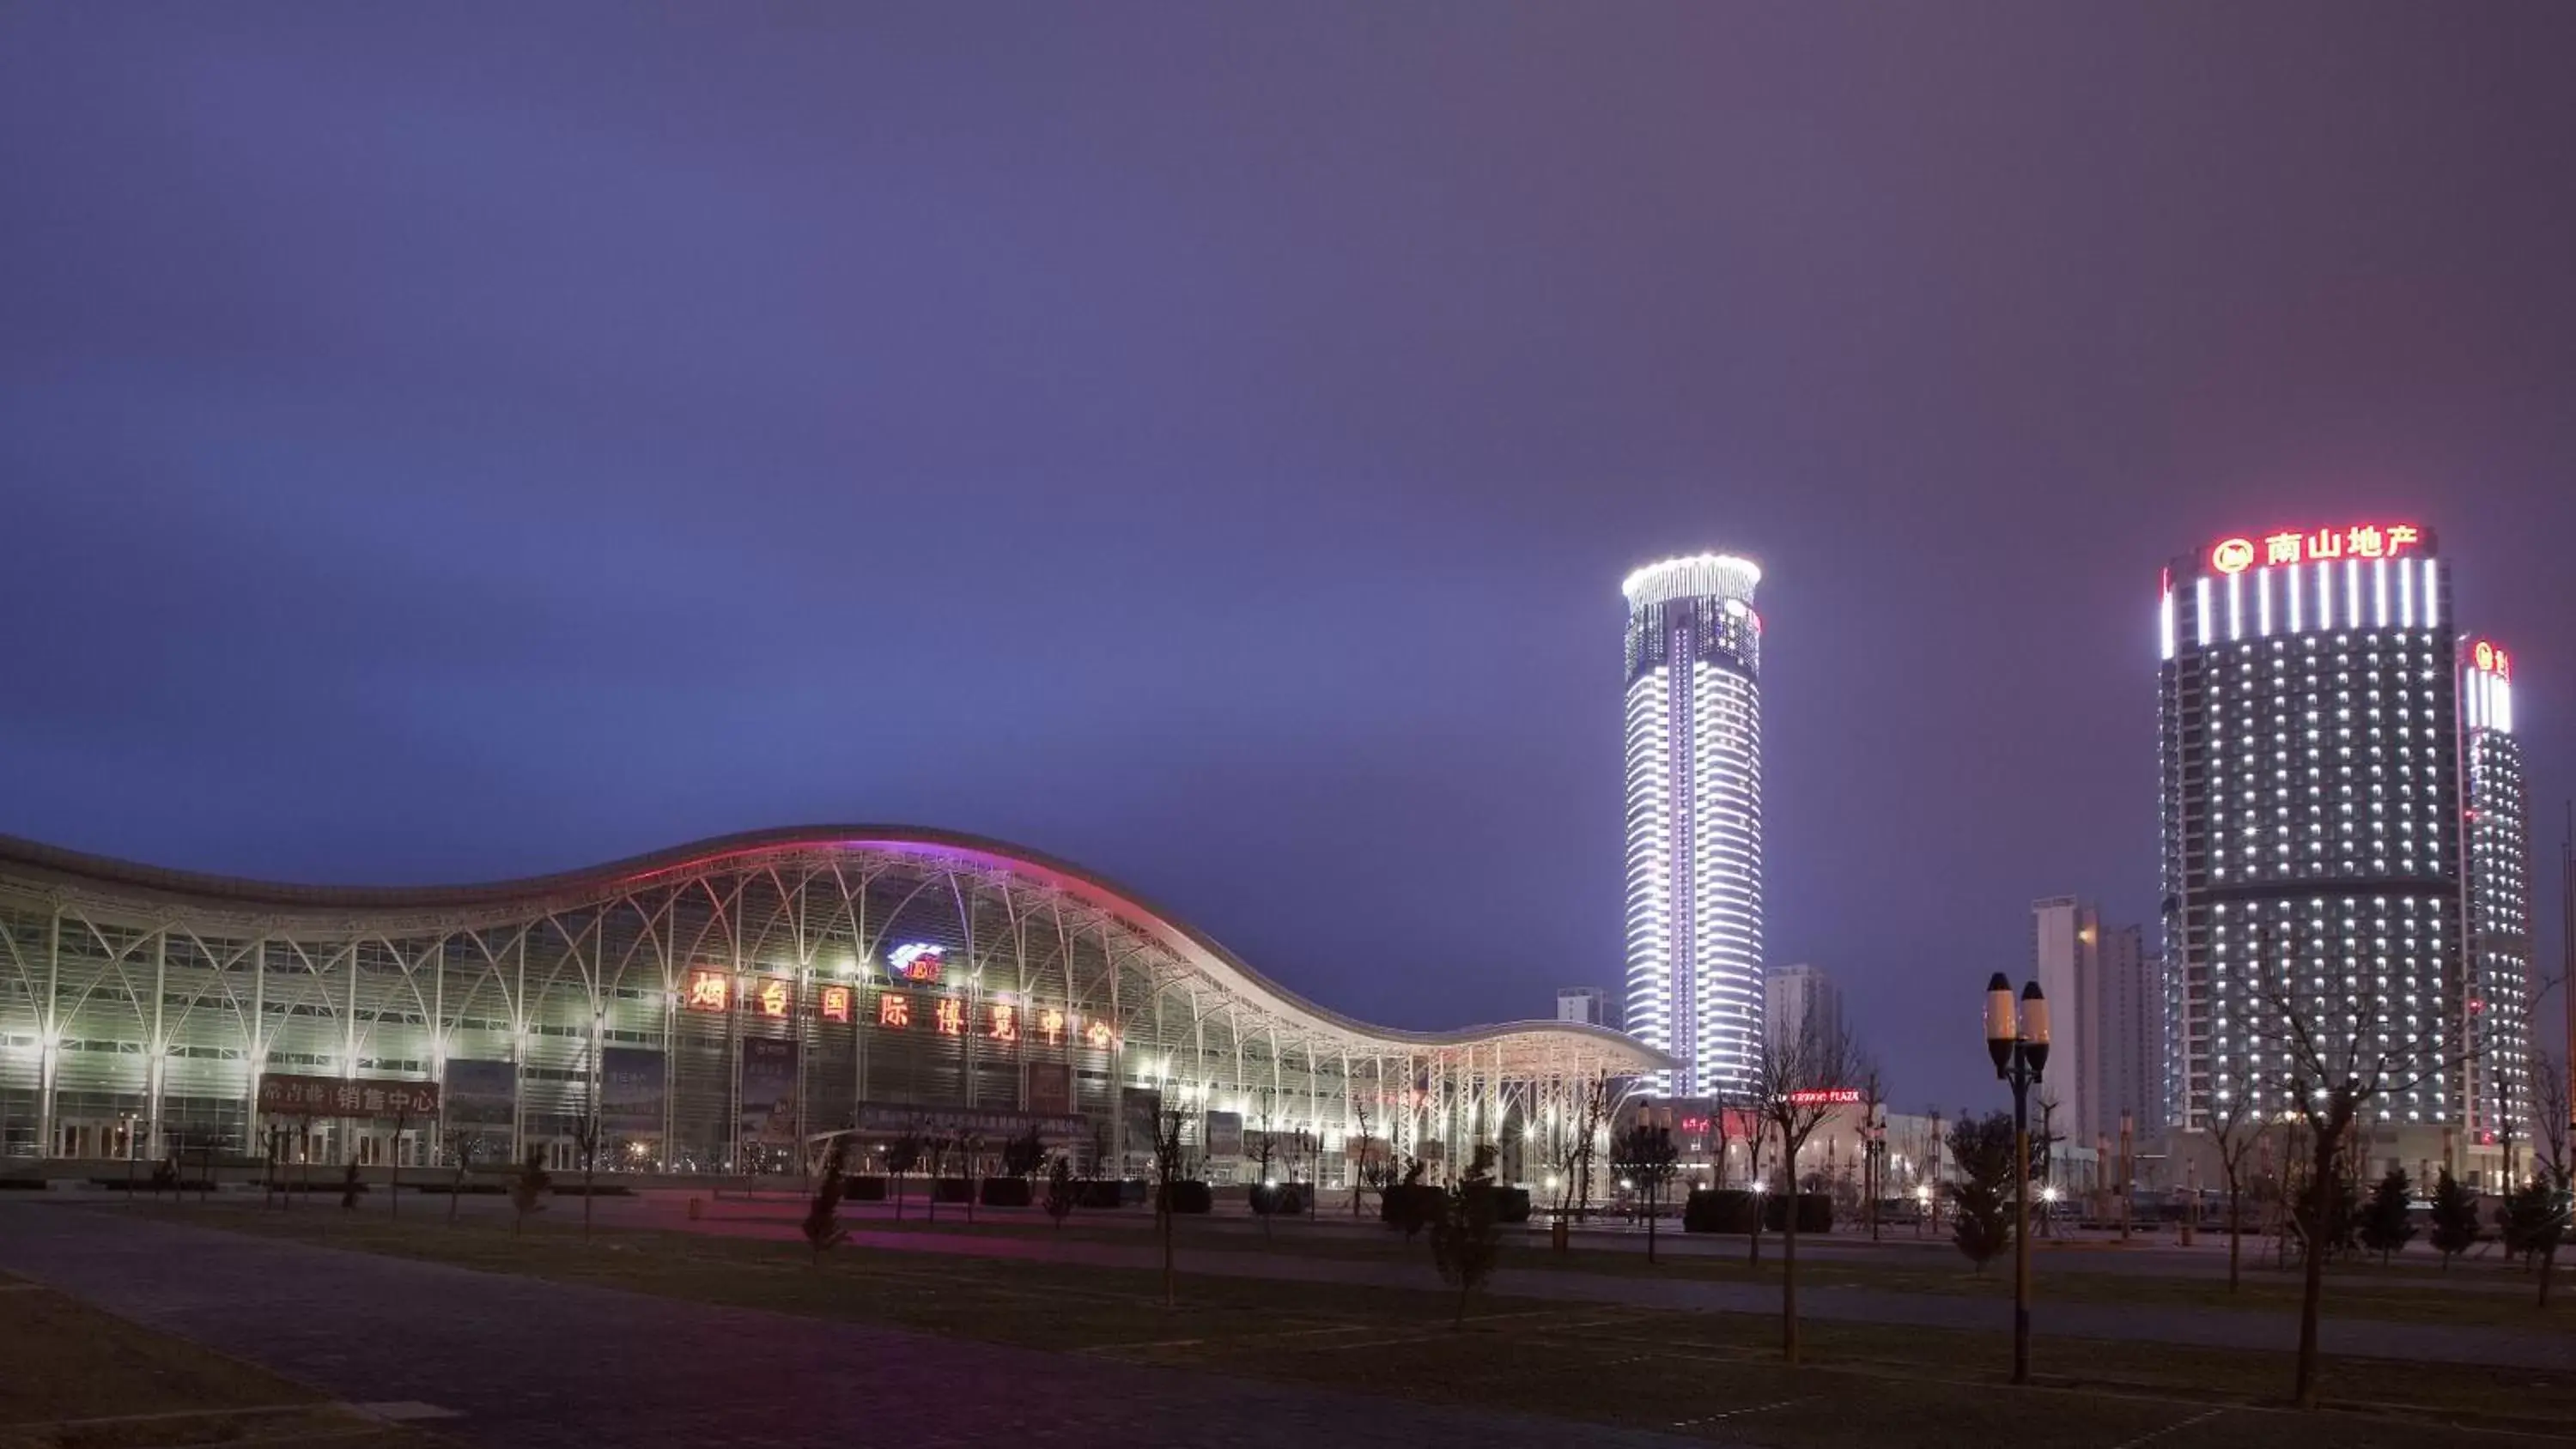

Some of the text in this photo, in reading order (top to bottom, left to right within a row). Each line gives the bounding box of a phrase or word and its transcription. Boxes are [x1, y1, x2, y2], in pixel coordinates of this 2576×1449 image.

[2265, 525, 2418, 564] 南山地产
[690, 971, 1116, 1049] 烟台国际博览中心
[337, 1086, 435, 1113] 销售中心
[1830, 1091, 1859, 1101] PLAZA
